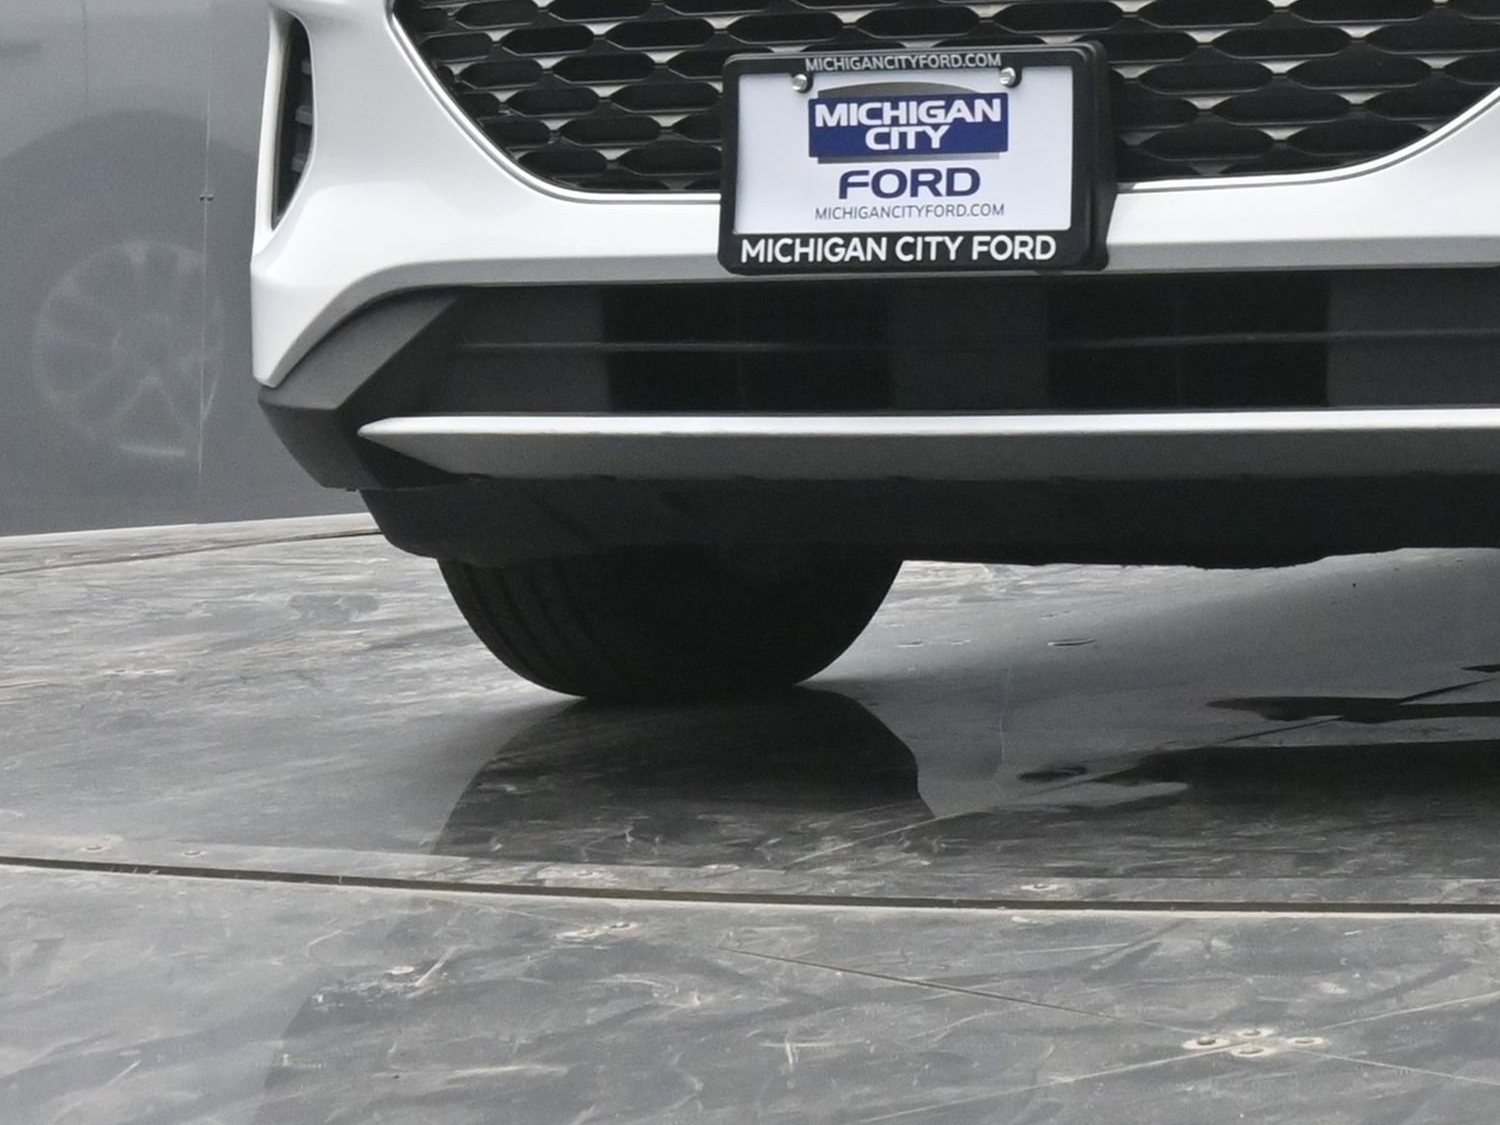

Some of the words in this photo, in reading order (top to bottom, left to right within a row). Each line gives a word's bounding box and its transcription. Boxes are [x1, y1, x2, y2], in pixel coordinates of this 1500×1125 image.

[805, 52, 1001, 73] MICHIGANCITYFORD.COM
[814, 98, 1001, 128] MICHIGAN
[865, 125, 951, 151] CITY
[838, 167, 981, 200] FORD
[814, 203, 1005, 221] MICHIGANCITYFORD.COM
[741, 236, 888, 264] MICHIGAN
[895, 235, 965, 262] CITY
[971, 234, 1057, 261] FORD
